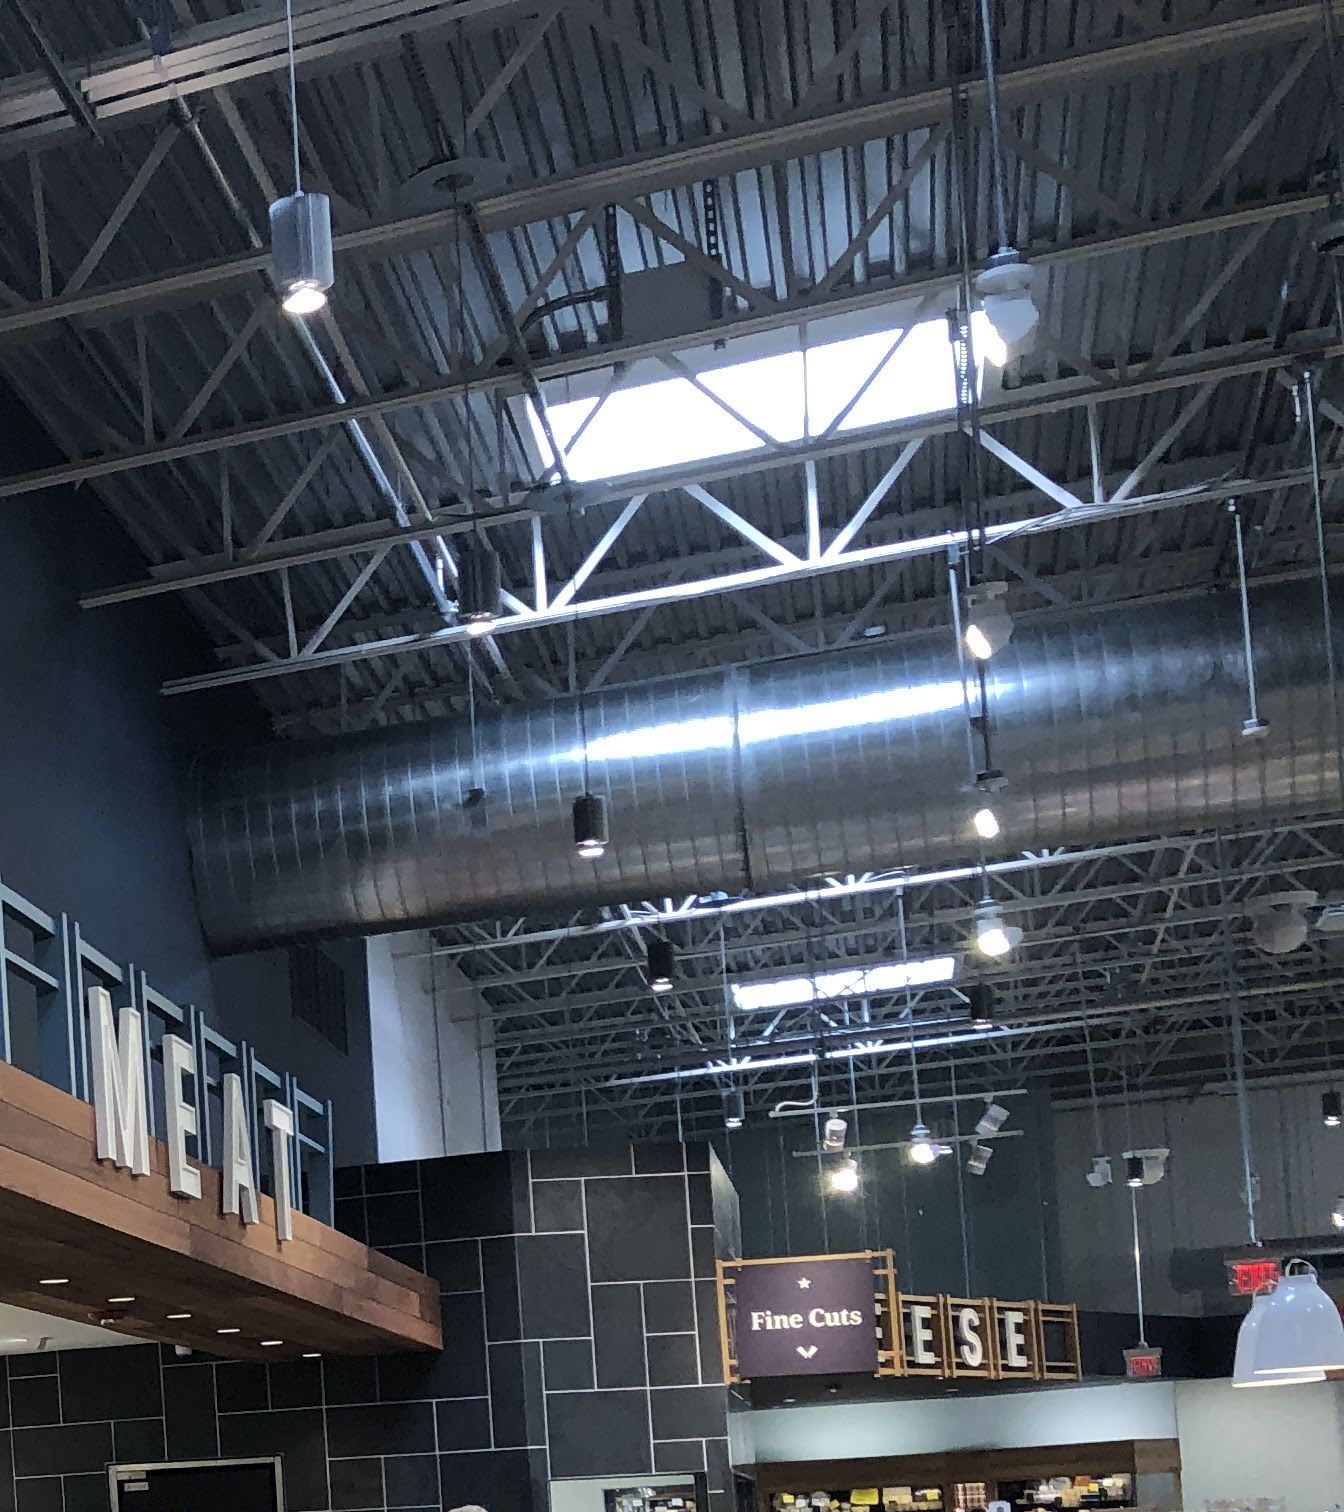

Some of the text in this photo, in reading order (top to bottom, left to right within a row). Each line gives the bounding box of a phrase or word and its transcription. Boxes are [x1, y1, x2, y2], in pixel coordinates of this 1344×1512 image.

[87, 986, 295, 1243] MEAT
[751, 1308, 863, 1331] Fine Cuts
